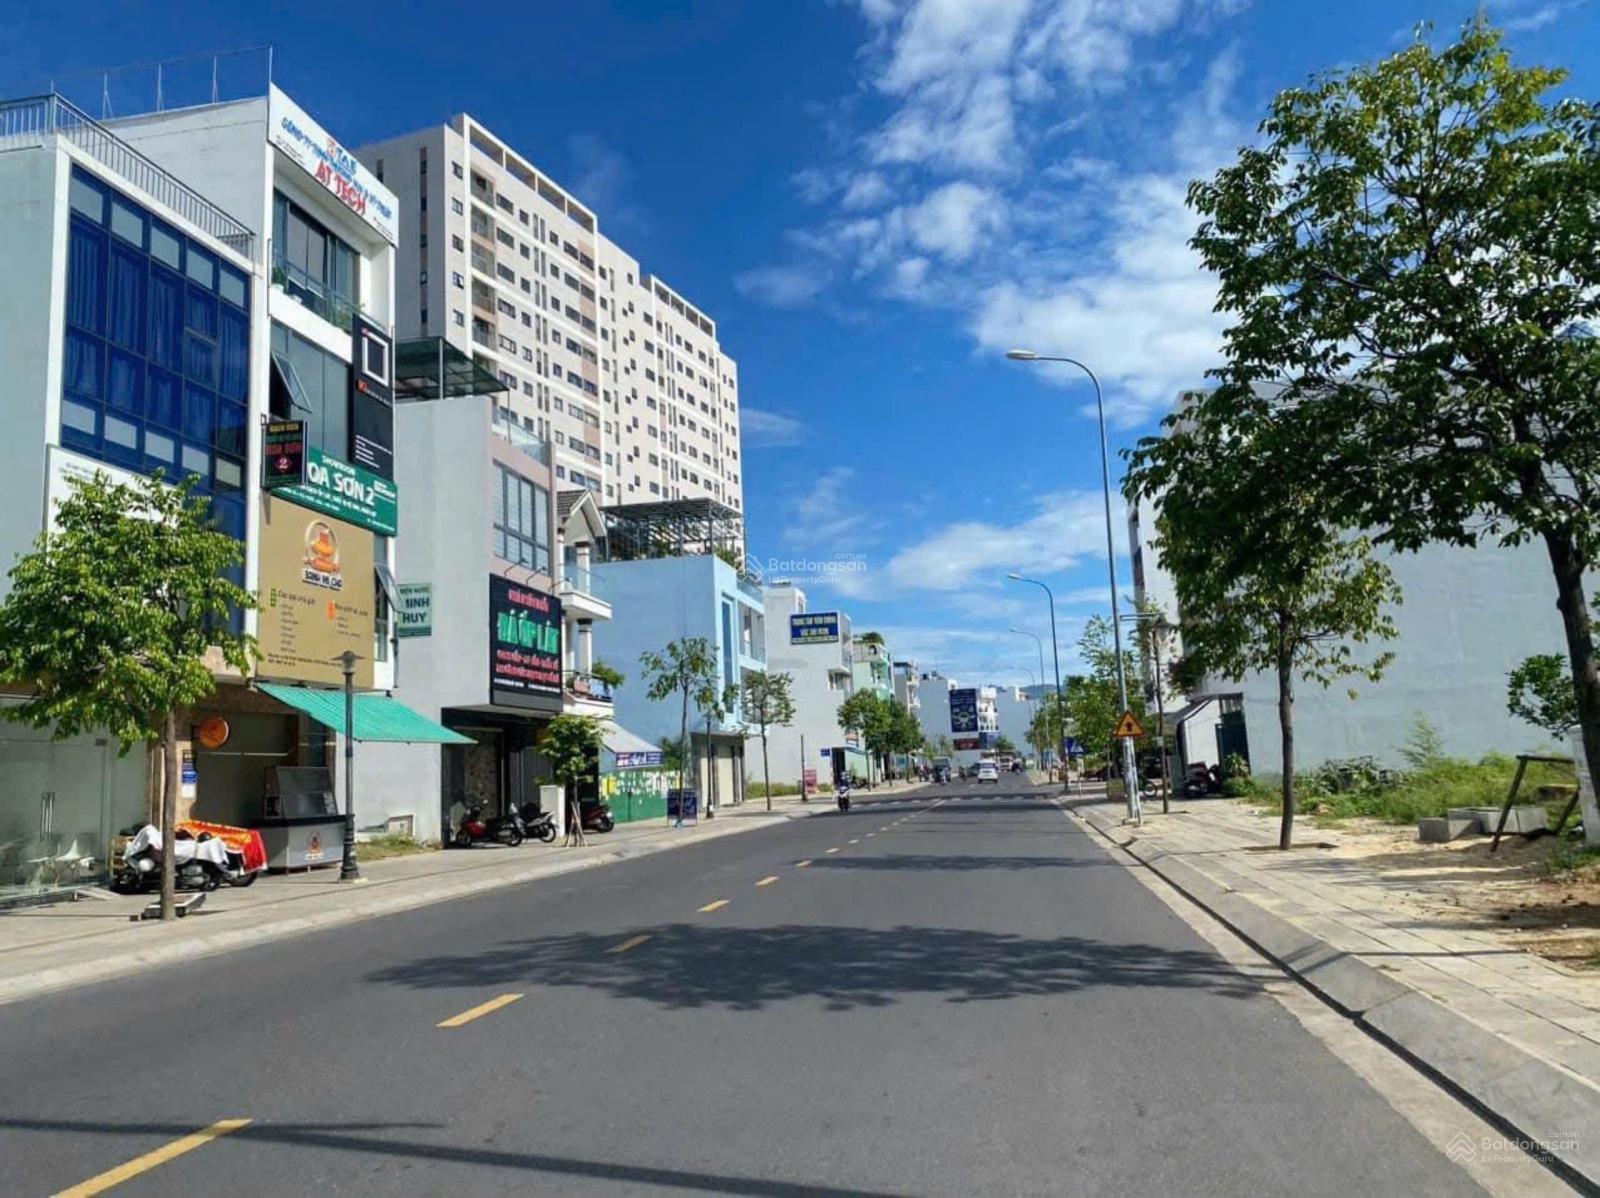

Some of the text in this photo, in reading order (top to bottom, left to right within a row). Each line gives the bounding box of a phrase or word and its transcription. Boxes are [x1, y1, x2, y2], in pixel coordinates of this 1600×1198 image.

[334, 175, 366, 215] TECH
[307, 462, 330, 488] OA
[333, 472, 365, 502] SƠN
[365, 487, 375, 506] 2
[403, 613, 426, 624] HUY
